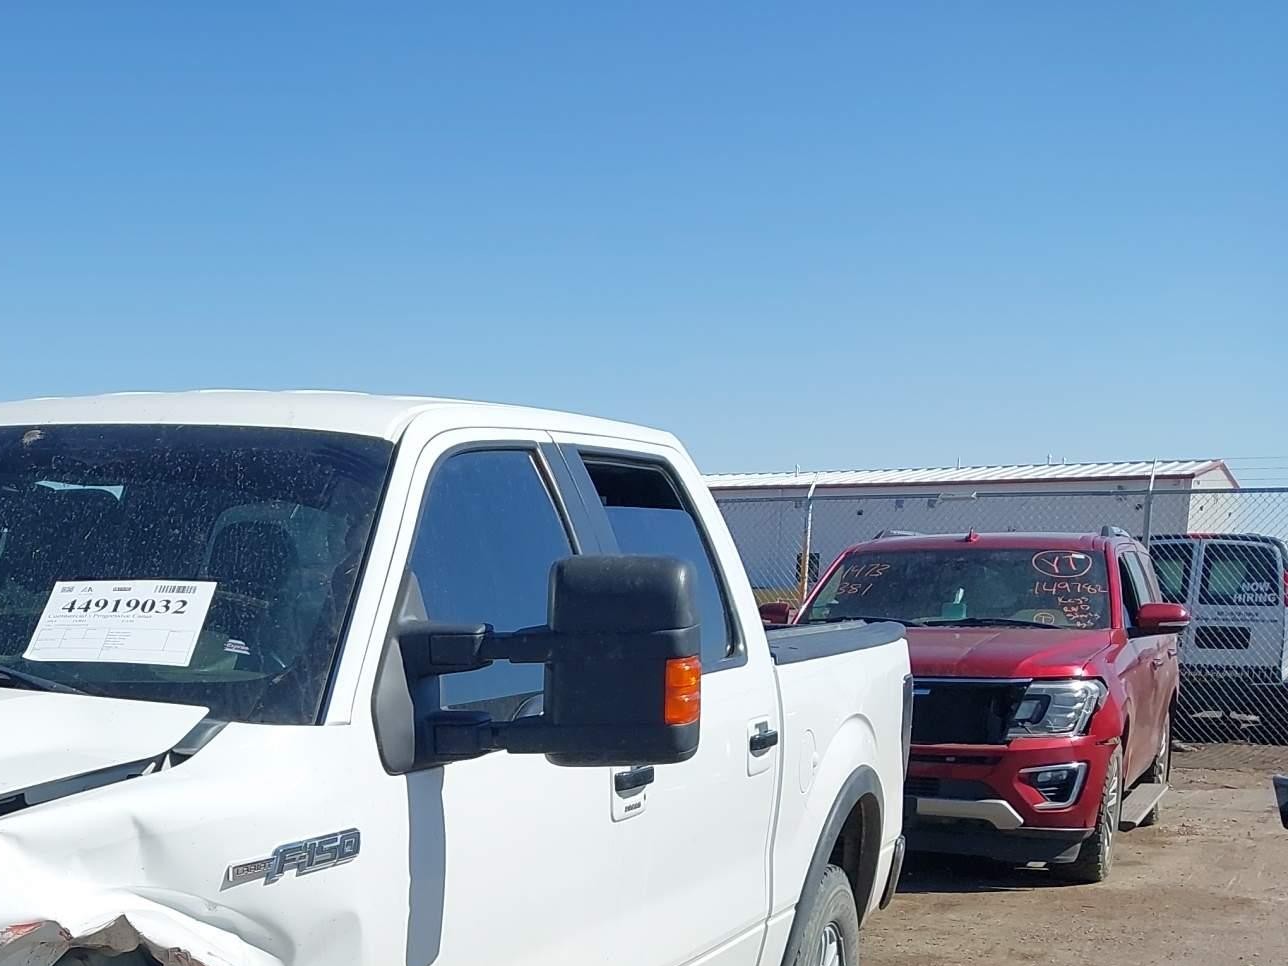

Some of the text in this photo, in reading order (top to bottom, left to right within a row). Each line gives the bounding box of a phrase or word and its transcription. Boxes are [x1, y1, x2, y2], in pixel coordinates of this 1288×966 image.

[1241, 581, 1271, 592] NOW
[1233, 593, 1277, 603] HIRING
[61, 598, 189, 615] 44919032
